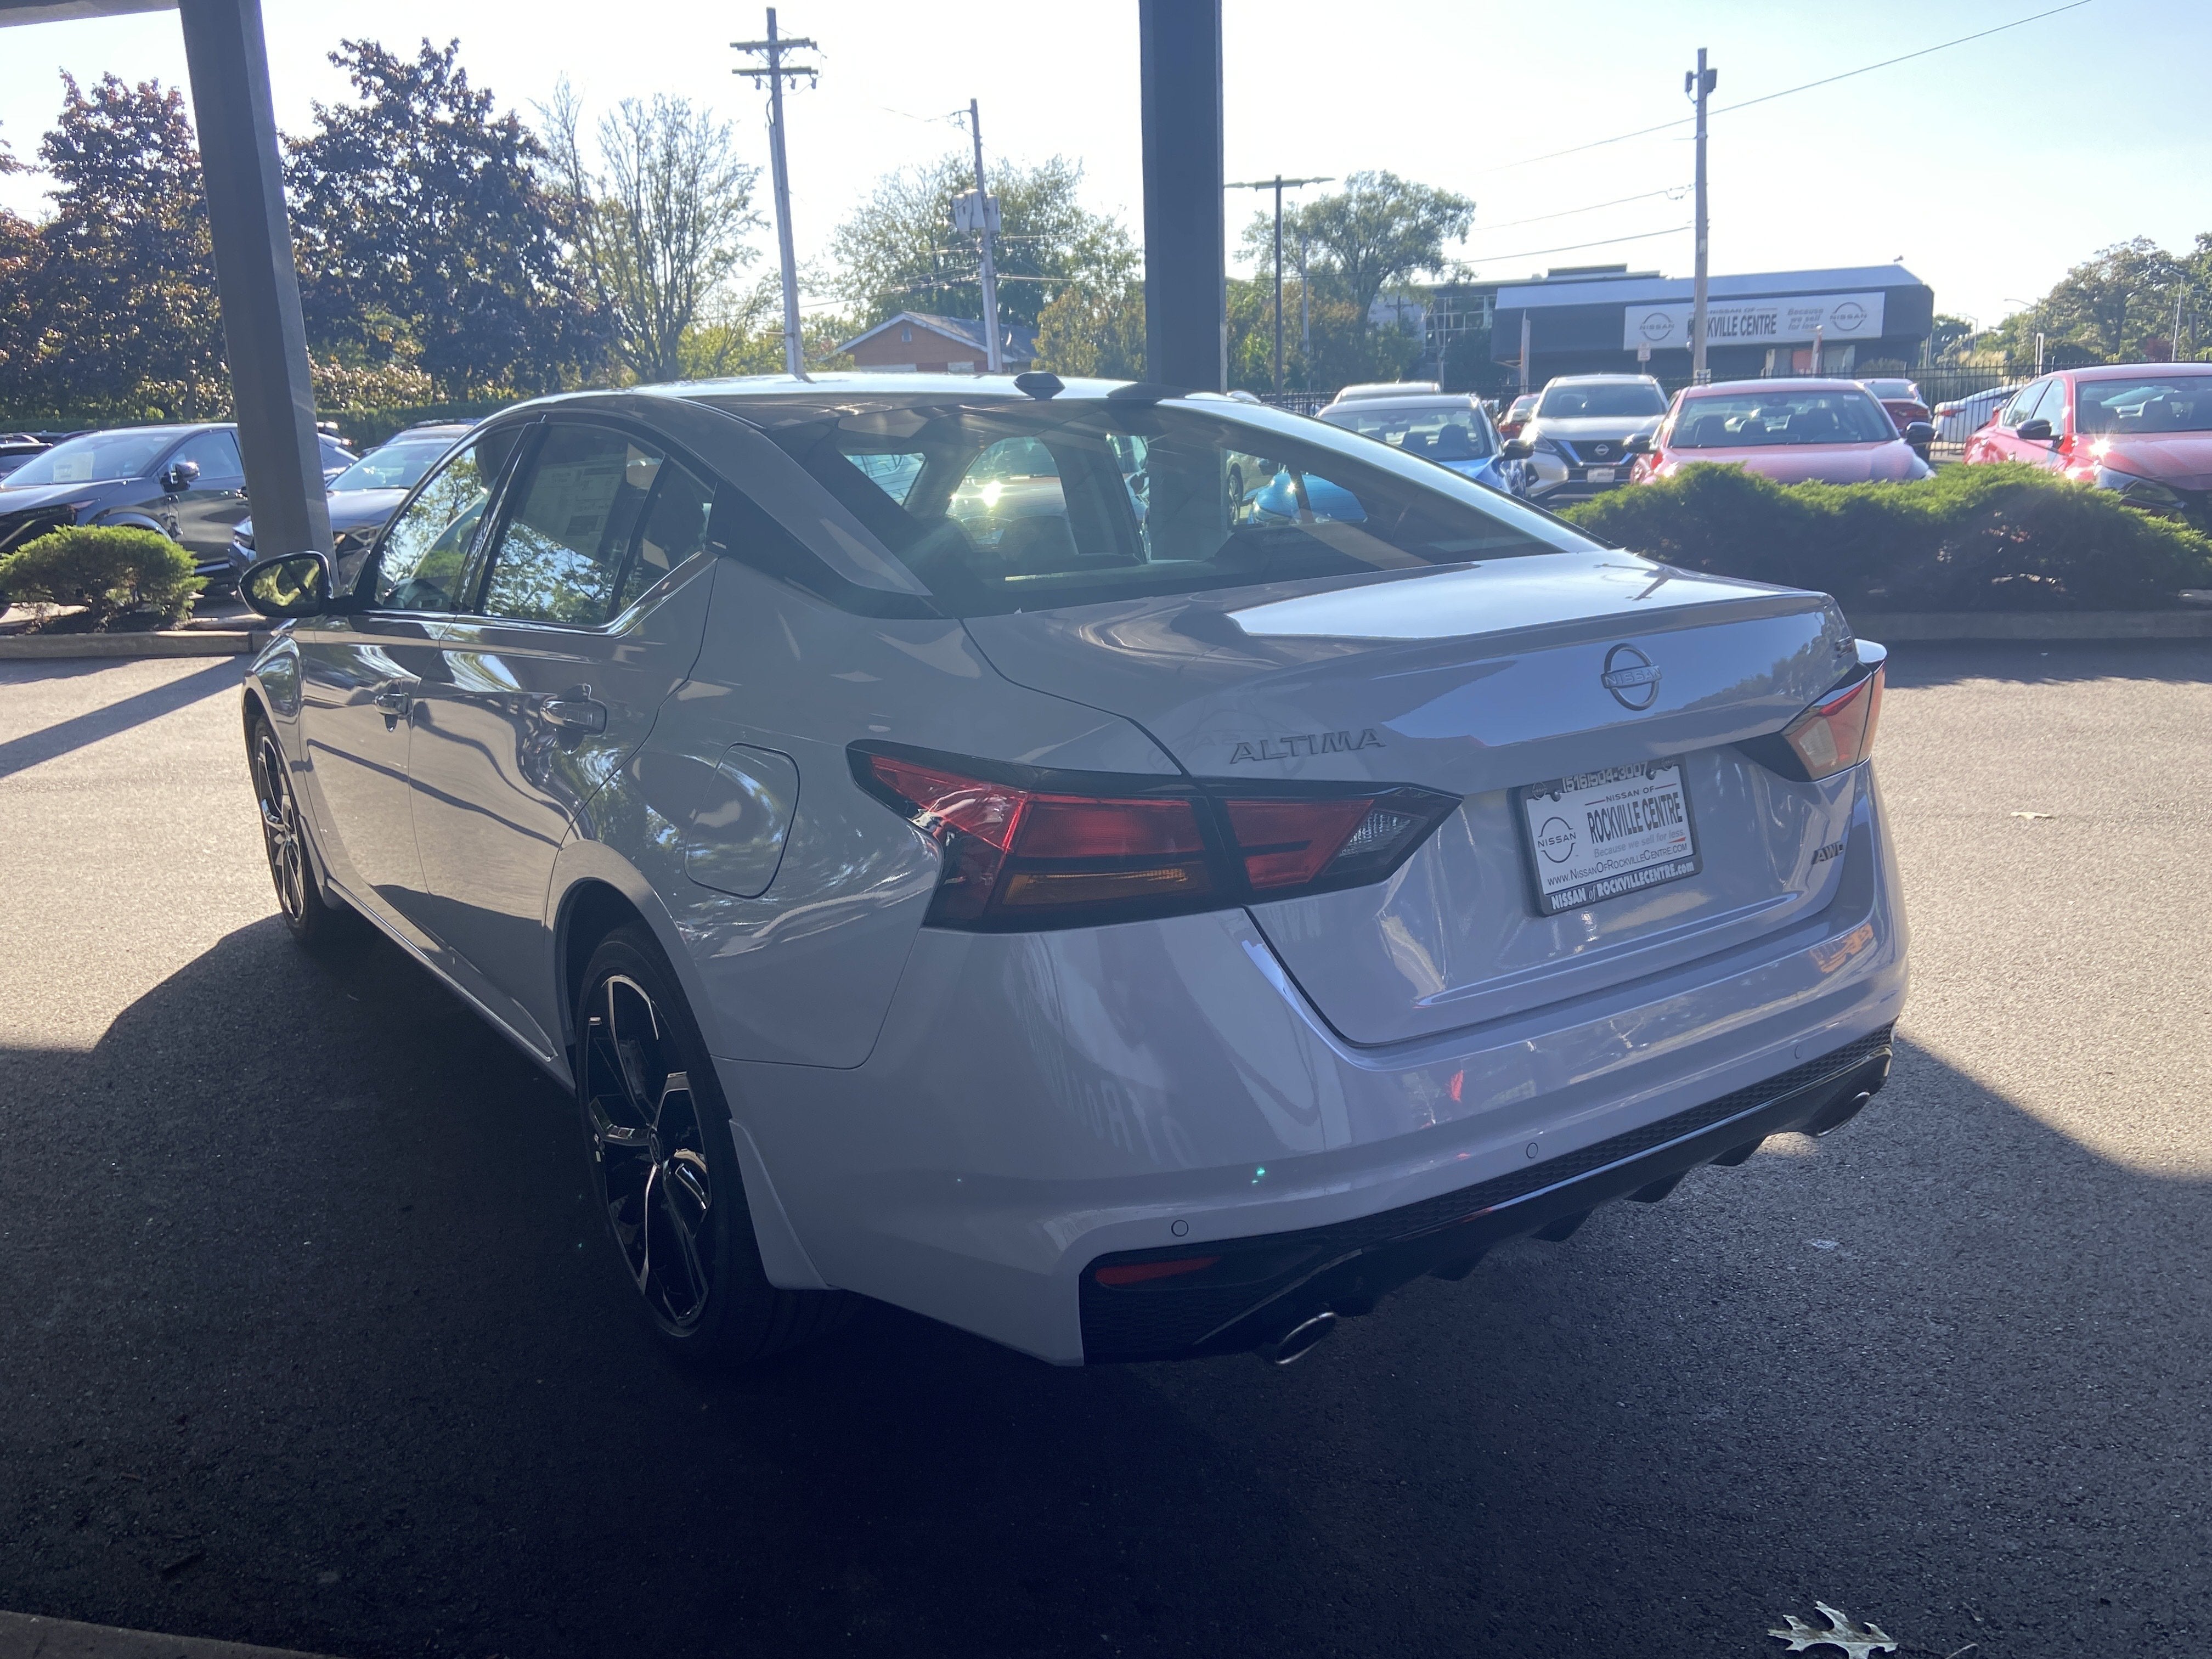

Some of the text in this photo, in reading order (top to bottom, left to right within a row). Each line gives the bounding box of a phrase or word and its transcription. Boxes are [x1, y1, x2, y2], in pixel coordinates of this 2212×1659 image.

[1688, 314, 1777, 338] RKVILLE CENTRE
[1604, 667, 1662, 686] NISSAN
[1229, 728, 1387, 764] ALTIMA
[1605, 786, 1655, 803] NISSAN OF
[1587, 792, 1683, 844] ROCKVILLE CENTRE
[1537, 832, 1576, 848] NISSAN
[1594, 844, 1627, 858] Because
[1628, 840, 1640, 849] we
[1641, 834, 1655, 847] sell
[1656, 833, 1667, 842] for
[1551, 861, 1695, 910] NISSAN of ROCKVILLECENTRE.com
